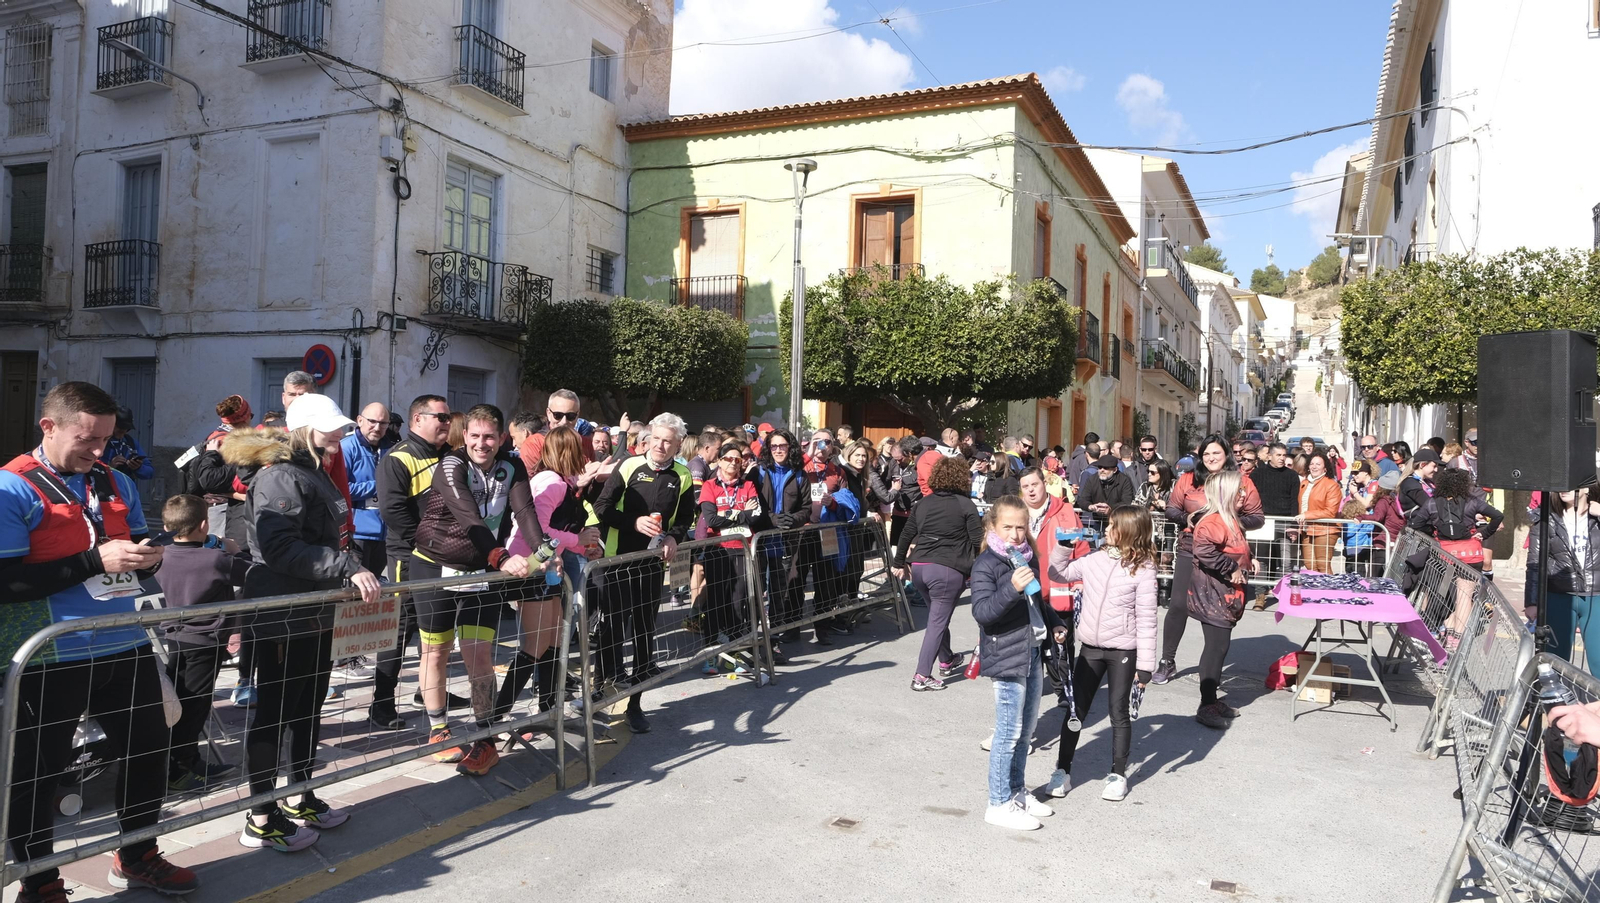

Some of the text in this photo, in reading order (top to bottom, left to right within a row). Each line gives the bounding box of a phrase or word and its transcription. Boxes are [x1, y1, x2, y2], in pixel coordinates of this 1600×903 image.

[341, 599, 395, 619] ALYSER DE
[333, 618, 397, 639] MAQUINARIA
